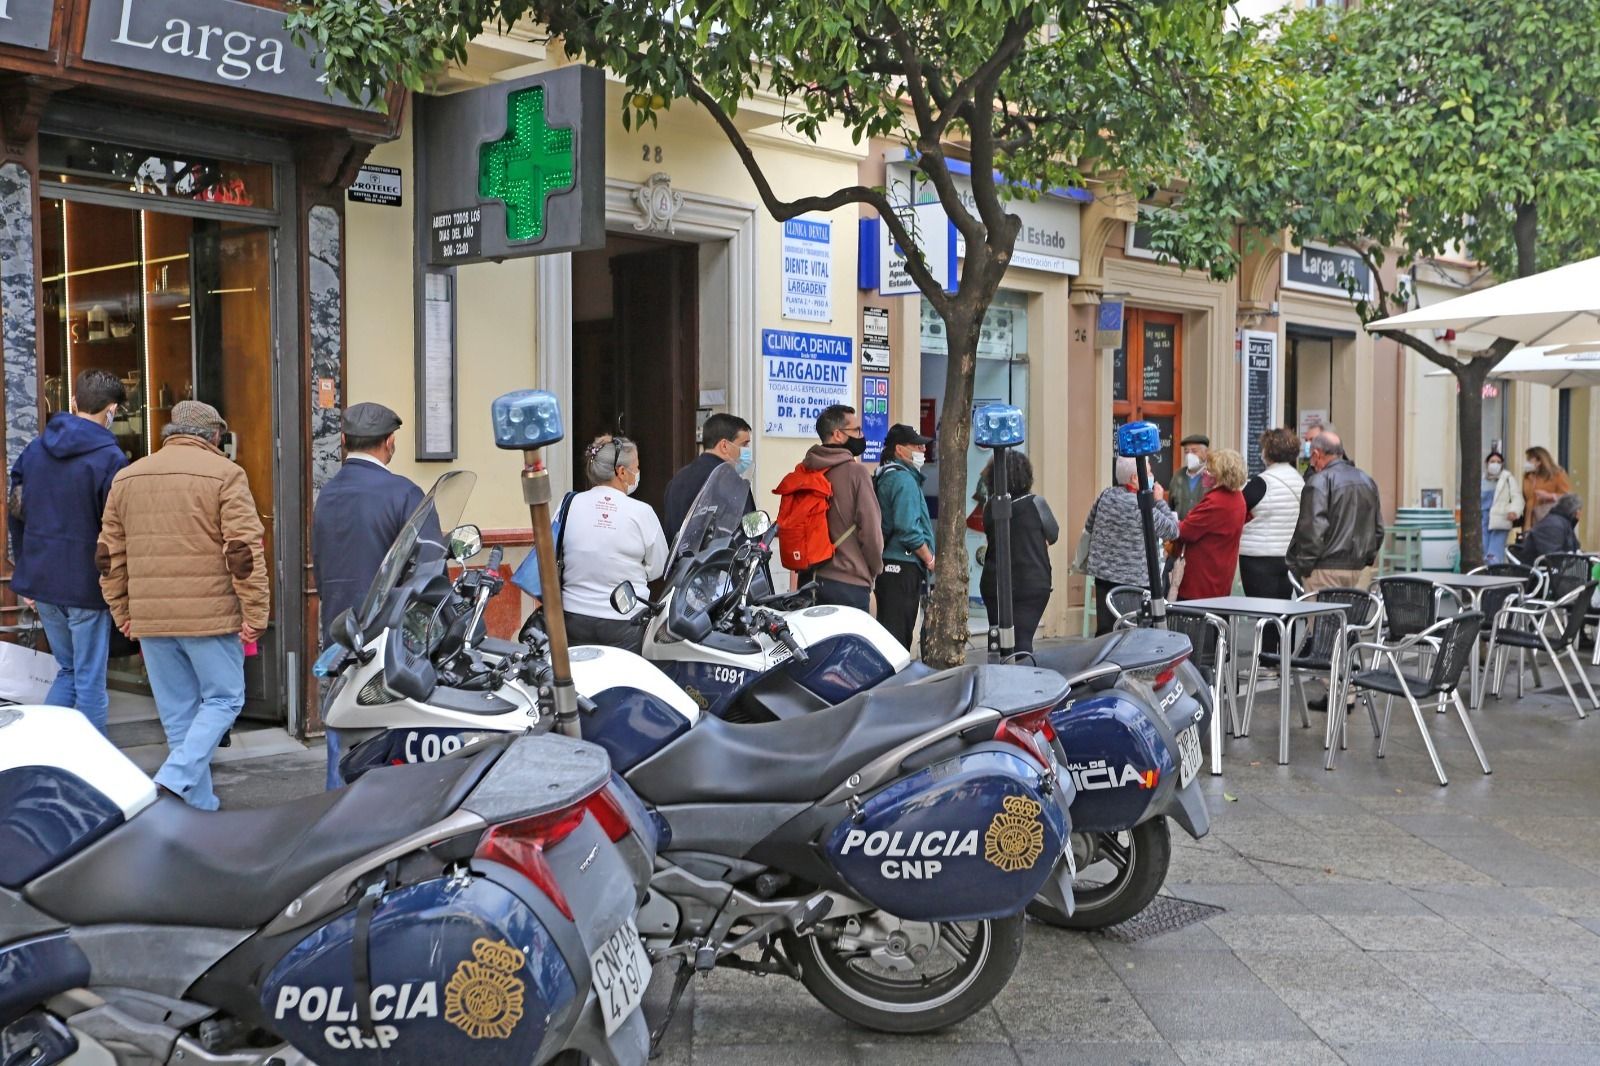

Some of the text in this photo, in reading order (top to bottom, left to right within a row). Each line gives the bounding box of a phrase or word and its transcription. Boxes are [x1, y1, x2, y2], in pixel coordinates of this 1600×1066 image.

[110, 0, 286, 81] Larga
[642, 144, 663, 164] 28
[433, 209, 481, 229] ABIERTO TODOS LOS
[452, 227, 461, 240] DEL
[463, 223, 474, 238] AÑO
[809, 224, 829, 241] DENTAL
[1028, 227, 1065, 249] Estado
[785, 257, 829, 278] DIENTE VITAL
[1302, 249, 1337, 282] Larga,
[787, 280, 827, 296] LARGADENT
[888, 279, 912, 288] Estado
[768, 333, 807, 352] CLINICA
[809, 338, 848, 355] DENTAL
[770, 360, 847, 383] LARGADENT
[769, 383, 789, 391] TODAS
[802, 385, 848, 395] ESPECIALIDADES
[808, 396, 840, 405] Dentista
[778, 406, 824, 419] DR. FLO
[777, 424, 783, 432] A
[715, 666, 745, 685] C091
[1089, 760, 1106, 769] DE
[1072, 763, 1147, 791] ICIA
[840, 829, 978, 856] POLICIA
[880, 860, 942, 880] CNP
[611, 951, 643, 1020] 4197
[274, 981, 439, 1022] POLCIA
